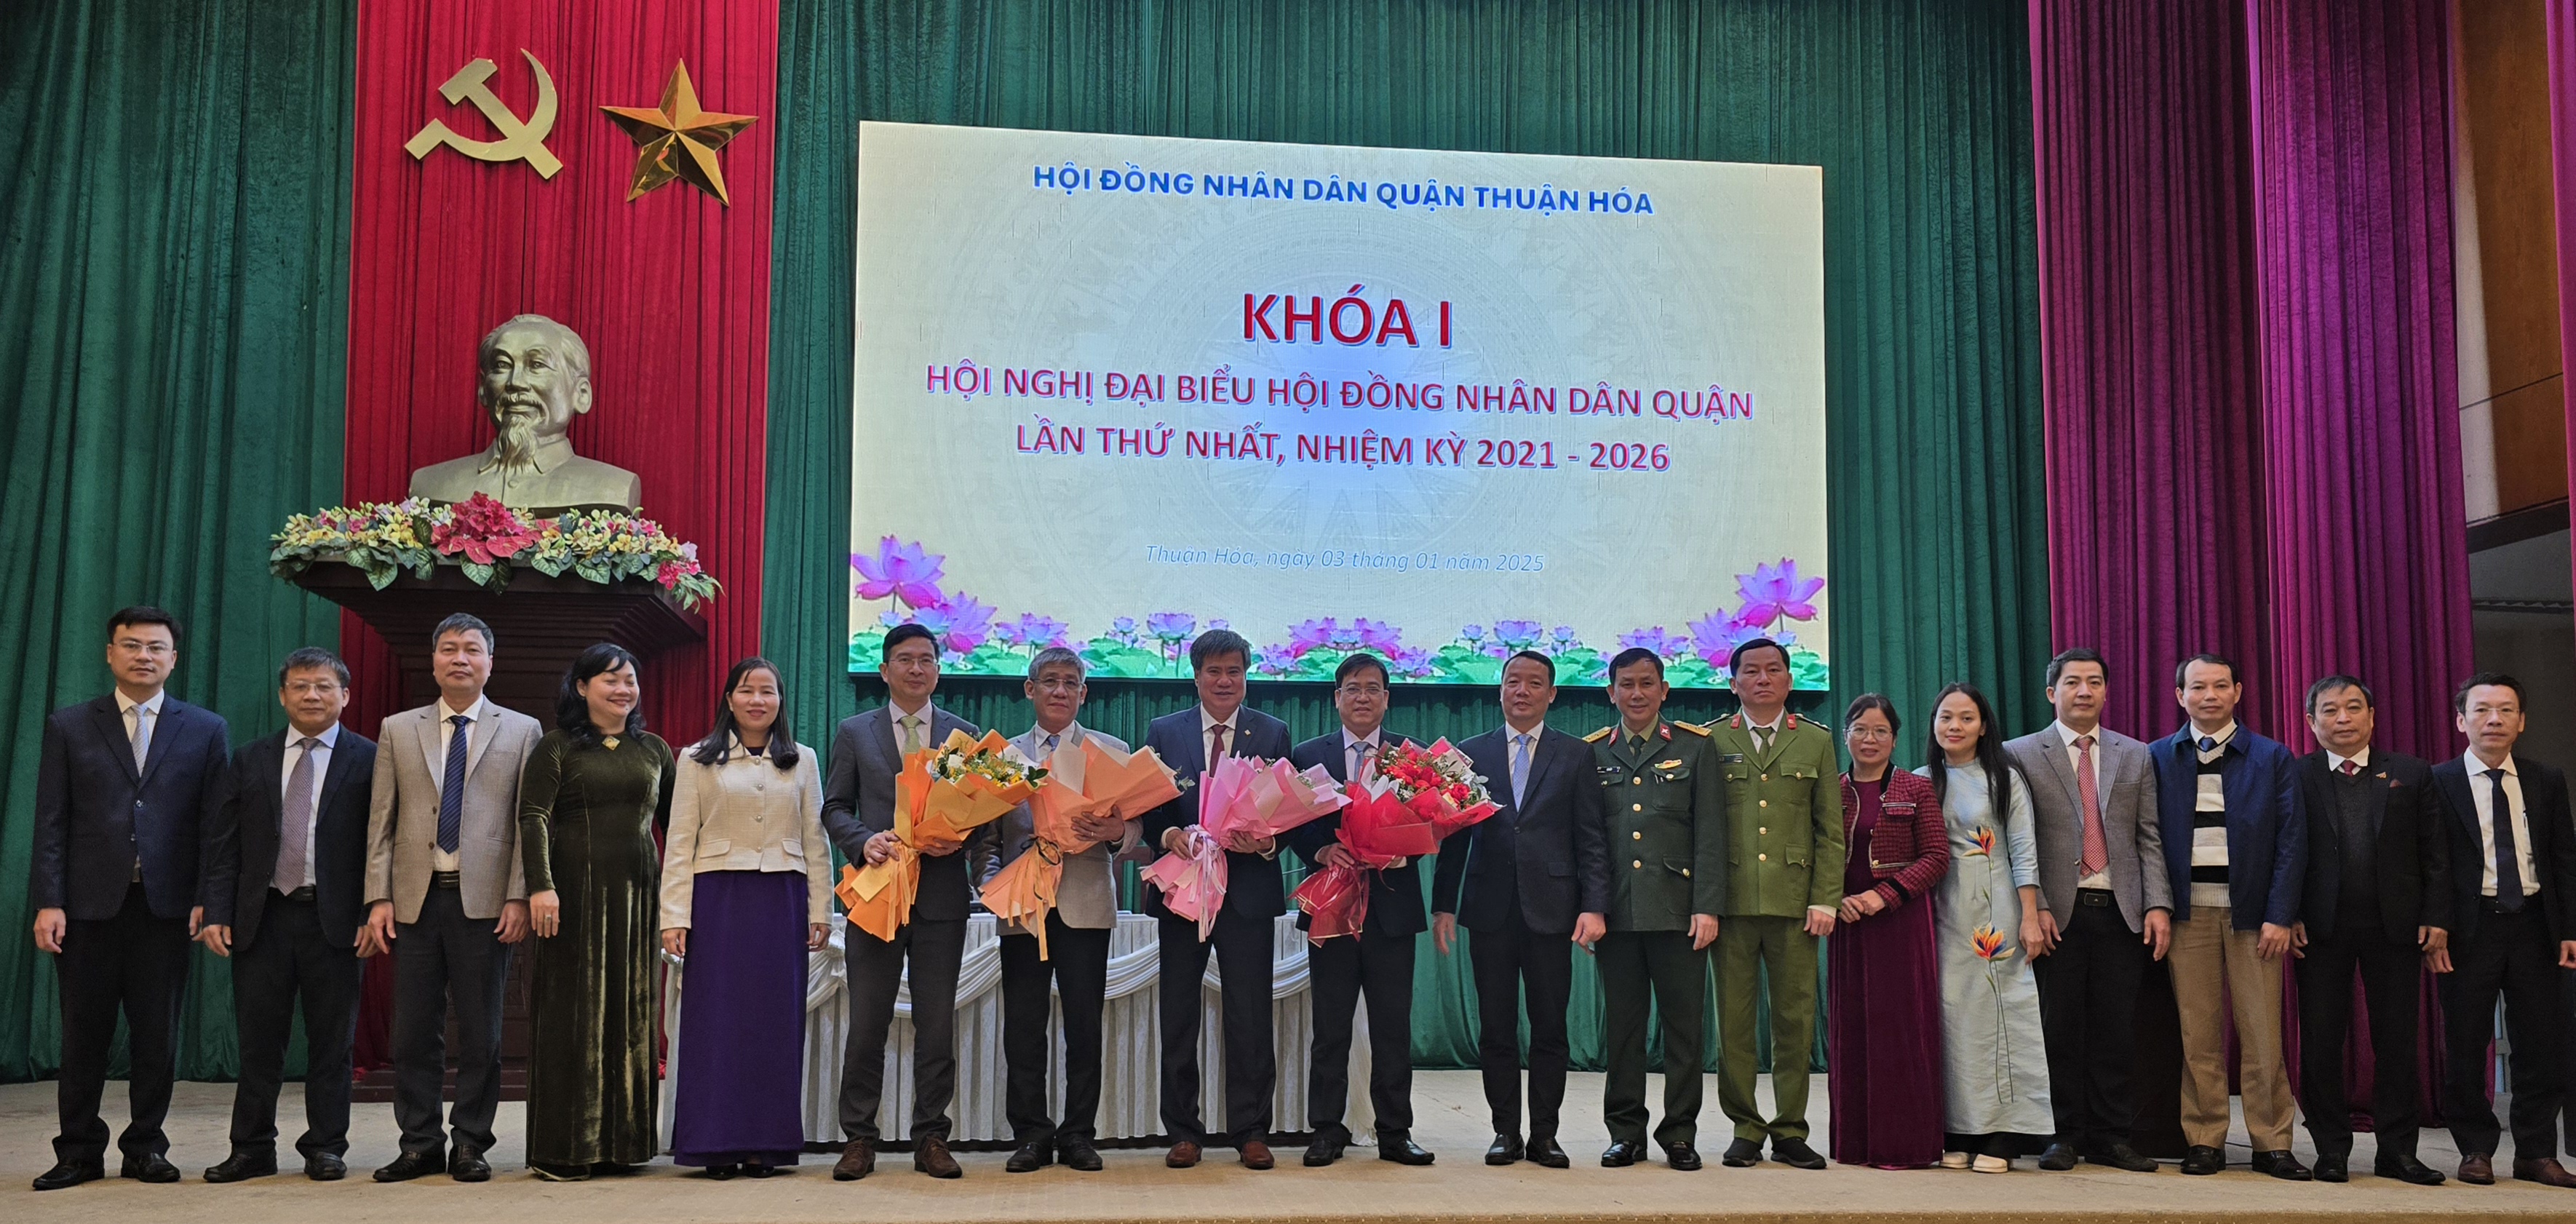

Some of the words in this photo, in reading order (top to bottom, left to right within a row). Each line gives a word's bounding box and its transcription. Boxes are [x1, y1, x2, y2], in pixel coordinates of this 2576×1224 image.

[1034, 162, 1090, 194] HỘI
[1100, 162, 1194, 194] ĐỒNG
[1204, 171, 1293, 199] NHÂN
[1303, 175, 1367, 202] DÂN
[1376, 179, 1464, 212] QUẬN
[1474, 184, 1579, 216] THUẬN
[1589, 186, 1653, 214] HÓA
[1244, 284, 1419, 346] KHÓA
[1439, 300, 1451, 347] I
[926, 359, 990, 400] HỘI
[1003, 367, 1092, 405] NGHỊ
[1104, 373, 1164, 406] ĐẠI
[1177, 363, 1255, 404] BIỂU
[1268, 372, 1328, 412] HỘI
[1339, 370, 1444, 410] ĐỒNG
[1456, 378, 1556, 413] NHÂN
[1568, 381, 1641, 416] DÂN
[1652, 384, 1752, 424] QUẬN
[1017, 413, 1084, 453] LẦN
[1096, 421, 1174, 456] THỨ
[1185, 421, 1285, 465] NHẤT,
[1297, 428, 1412, 468] NHIỆM
[1426, 431, 1467, 465] KỲ
[1477, 439, 1557, 468] 2021
[1589, 442, 1670, 471] 2026
[1146, 545, 1207, 566] Thuận
[1213, 547, 1260, 568] Hóa,
[1265, 548, 1316, 570] ngày
[1321, 550, 1345, 567] 03
[1351, 550, 1410, 573] tháng
[1415, 552, 1439, 570] 01
[1445, 552, 1490, 571] năm
[1495, 554, 1545, 571] 2025
